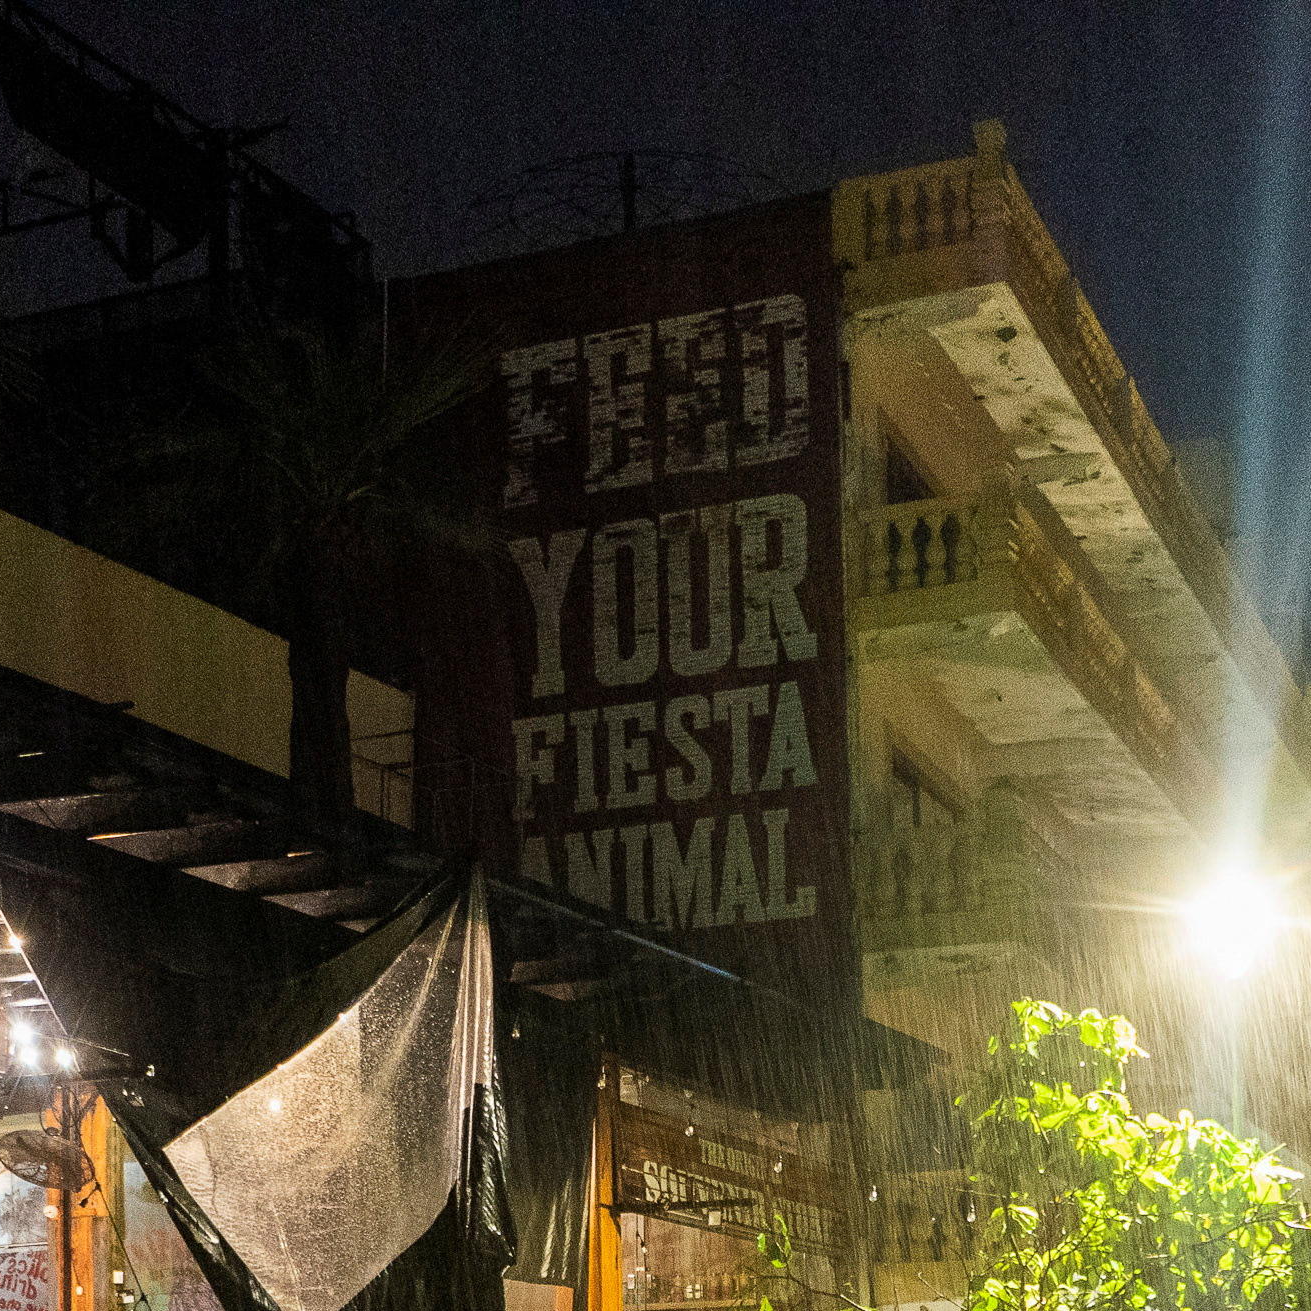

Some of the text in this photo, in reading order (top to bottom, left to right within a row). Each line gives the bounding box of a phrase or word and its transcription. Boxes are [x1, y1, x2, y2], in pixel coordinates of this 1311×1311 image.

[500, 292, 810, 511] FEED
[506, 492, 818, 701] YOUR
[511, 680, 818, 821] FIESTA
[519, 808, 817, 933] ANIMAL
